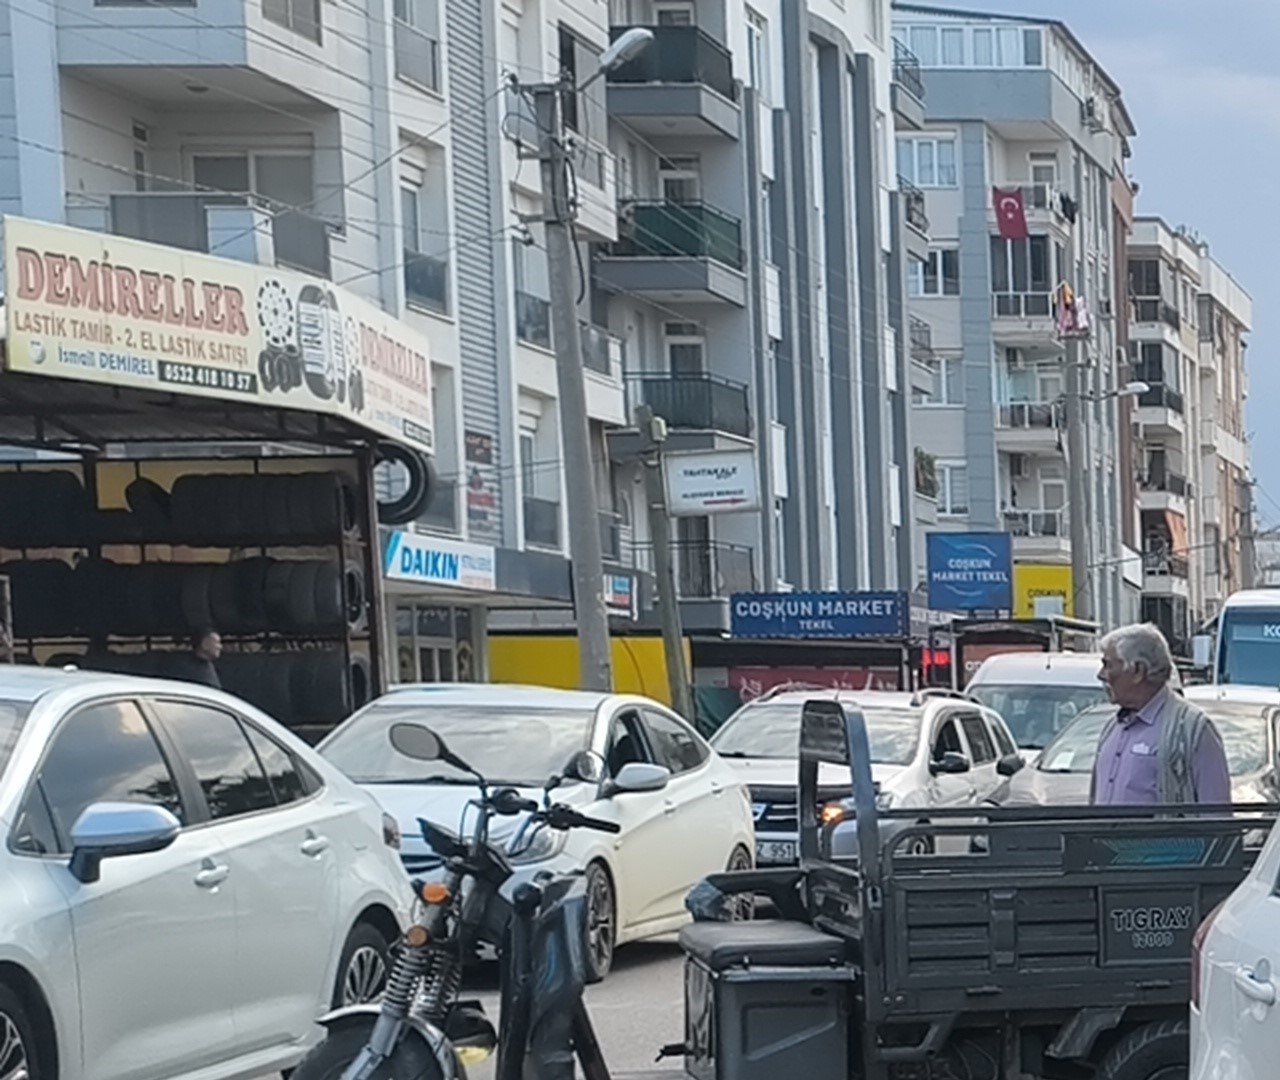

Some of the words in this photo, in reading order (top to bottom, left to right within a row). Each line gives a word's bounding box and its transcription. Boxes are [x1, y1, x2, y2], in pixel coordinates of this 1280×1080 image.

[16, 247, 250, 336] DEMİRELLER
[14, 310, 68, 337] LASTİK
[125, 329, 138, 349] 2.
[140, 331, 157, 351] EL
[160, 334, 210, 360] LASTİK
[99, 351, 155, 376] DEMİREL
[402, 547, 459, 580] DAIKIN
[948, 558, 992, 571] COŞKUN
[932, 571, 974, 582] MARKET
[976, 571, 1009, 582] TEKEL
[735, 600, 813, 619] COŞKUN
[818, 600, 894, 616] MARKET
[799, 619, 834, 631] TEKEL
[1111, 906, 1192, 931] TIGRAY
